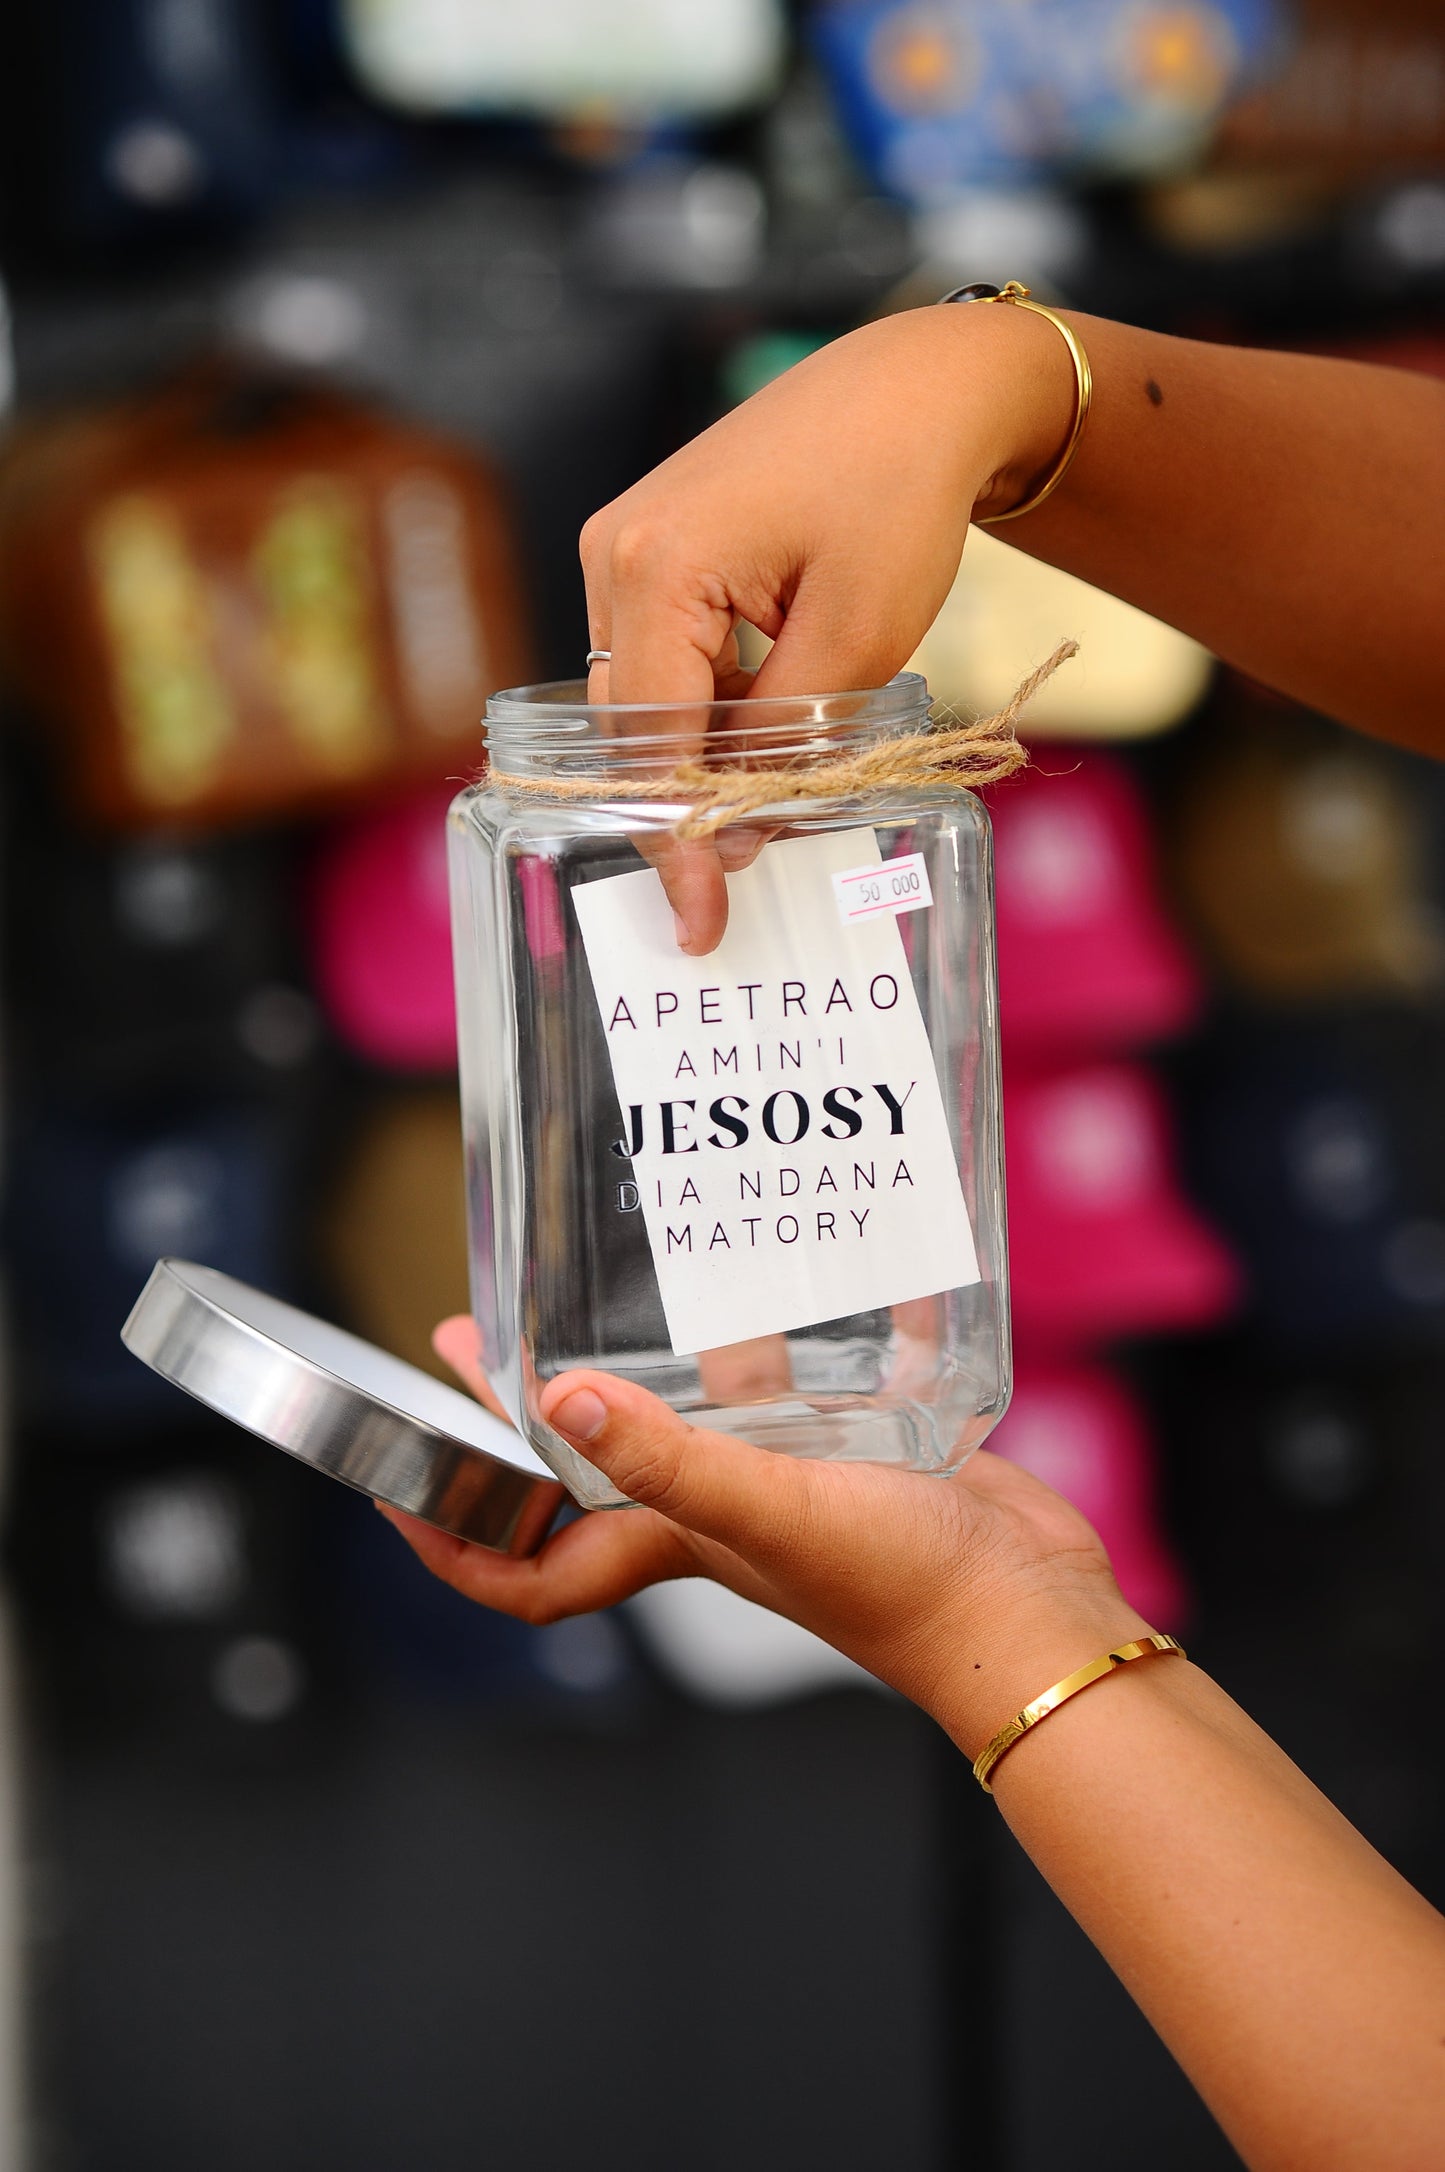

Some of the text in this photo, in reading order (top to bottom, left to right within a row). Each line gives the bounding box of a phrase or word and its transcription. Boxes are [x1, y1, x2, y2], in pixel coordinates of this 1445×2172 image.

[860, 872, 920, 903] 50 000
[608, 973, 899, 1032] APETRAO
[674, 1036, 845, 1079] AMIN'I
[611, 1080, 917, 1158] JESOSY
[616, 1159, 915, 1213] DIA NDANA
[666, 1208, 871, 1254] MATORY
